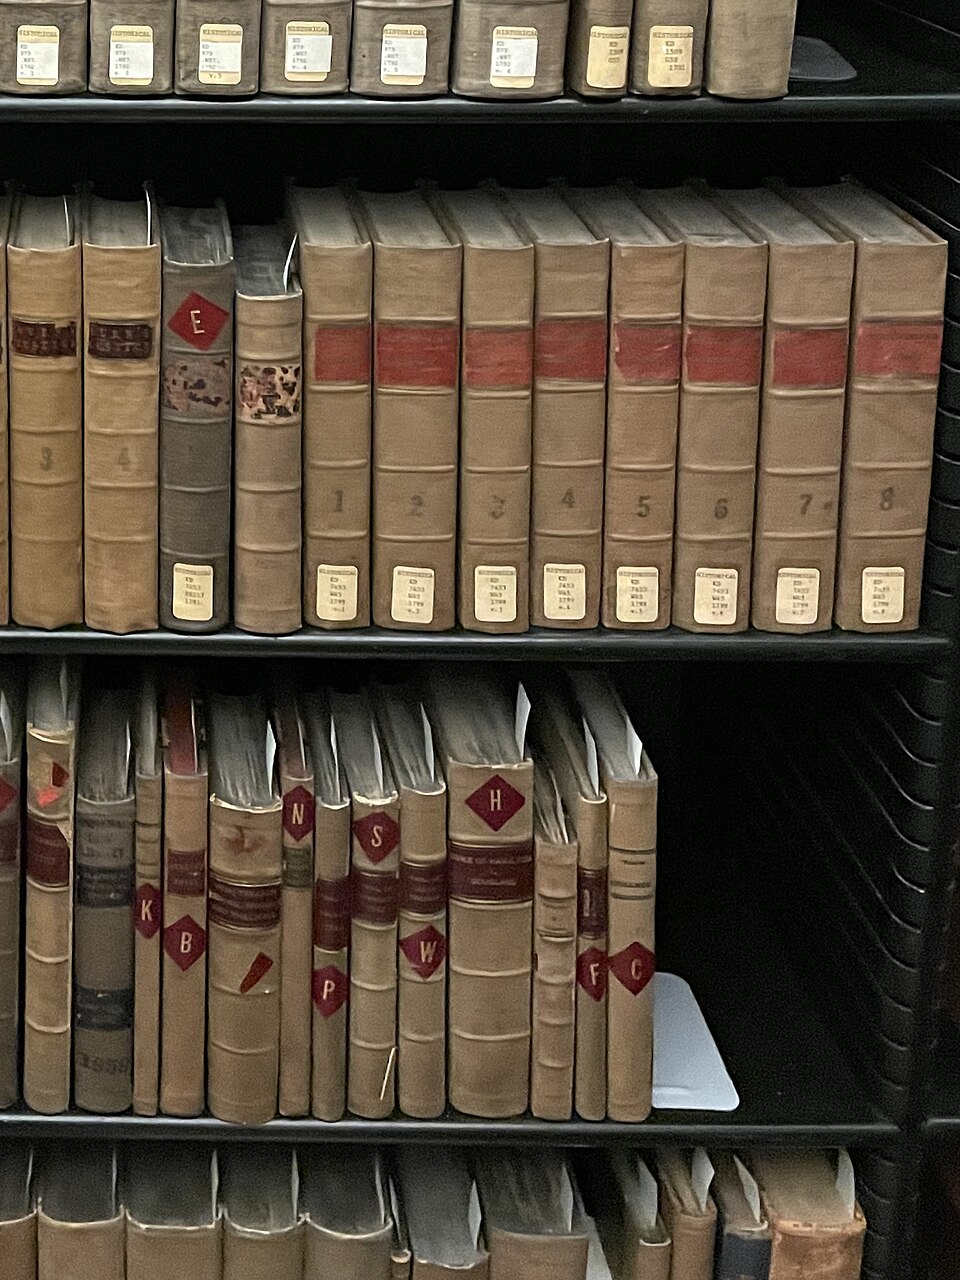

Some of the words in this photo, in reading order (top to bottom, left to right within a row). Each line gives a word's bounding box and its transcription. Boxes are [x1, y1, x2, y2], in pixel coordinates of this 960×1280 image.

[190, 309, 206, 334] E
[637, 495, 650, 518] 5
[714, 498, 728, 520] 6
[800, 494, 812, 515] 7
[879, 487, 894, 511] 8
[490, 789, 501, 810] H
[292, 803, 304, 824] N
[371, 825, 382, 847] S
[142, 900, 152, 922] K
[180, 932, 191, 953] B
[420, 941, 437, 962] W
[590, 963, 600, 985] F
[323, 980, 335, 1002] P
